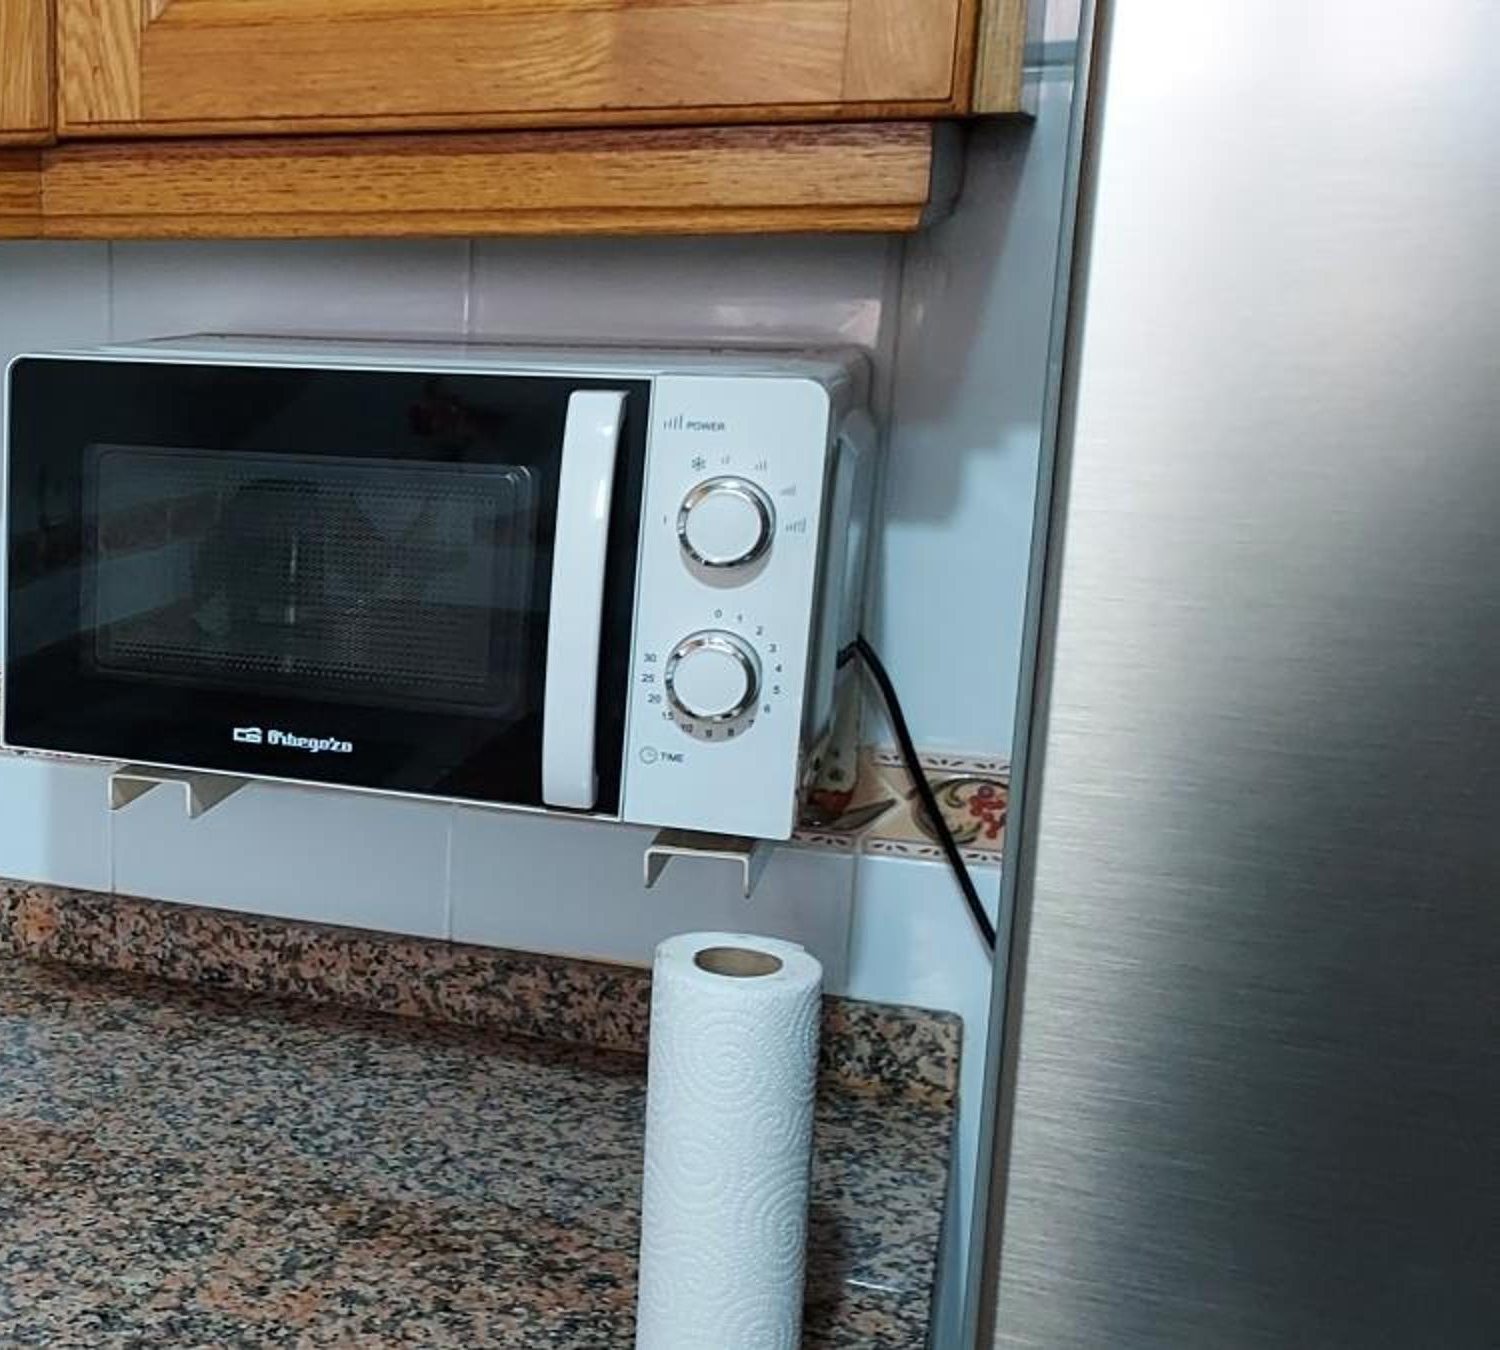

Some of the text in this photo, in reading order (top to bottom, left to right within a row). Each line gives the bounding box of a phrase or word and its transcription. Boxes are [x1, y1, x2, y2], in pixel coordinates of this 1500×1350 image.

[686, 422, 725, 432] POWER
[714, 609, 723, 618] 0
[756, 626, 763, 636] 2
[644, 654, 657, 663] 30
[775, 664, 782, 673] 4
[641, 674, 654, 683] 25
[648, 694, 662, 703] 20
[662, 712, 674, 721] 15
[681, 724, 694, 733] 10
[660, 752, 685, 763] TIME
